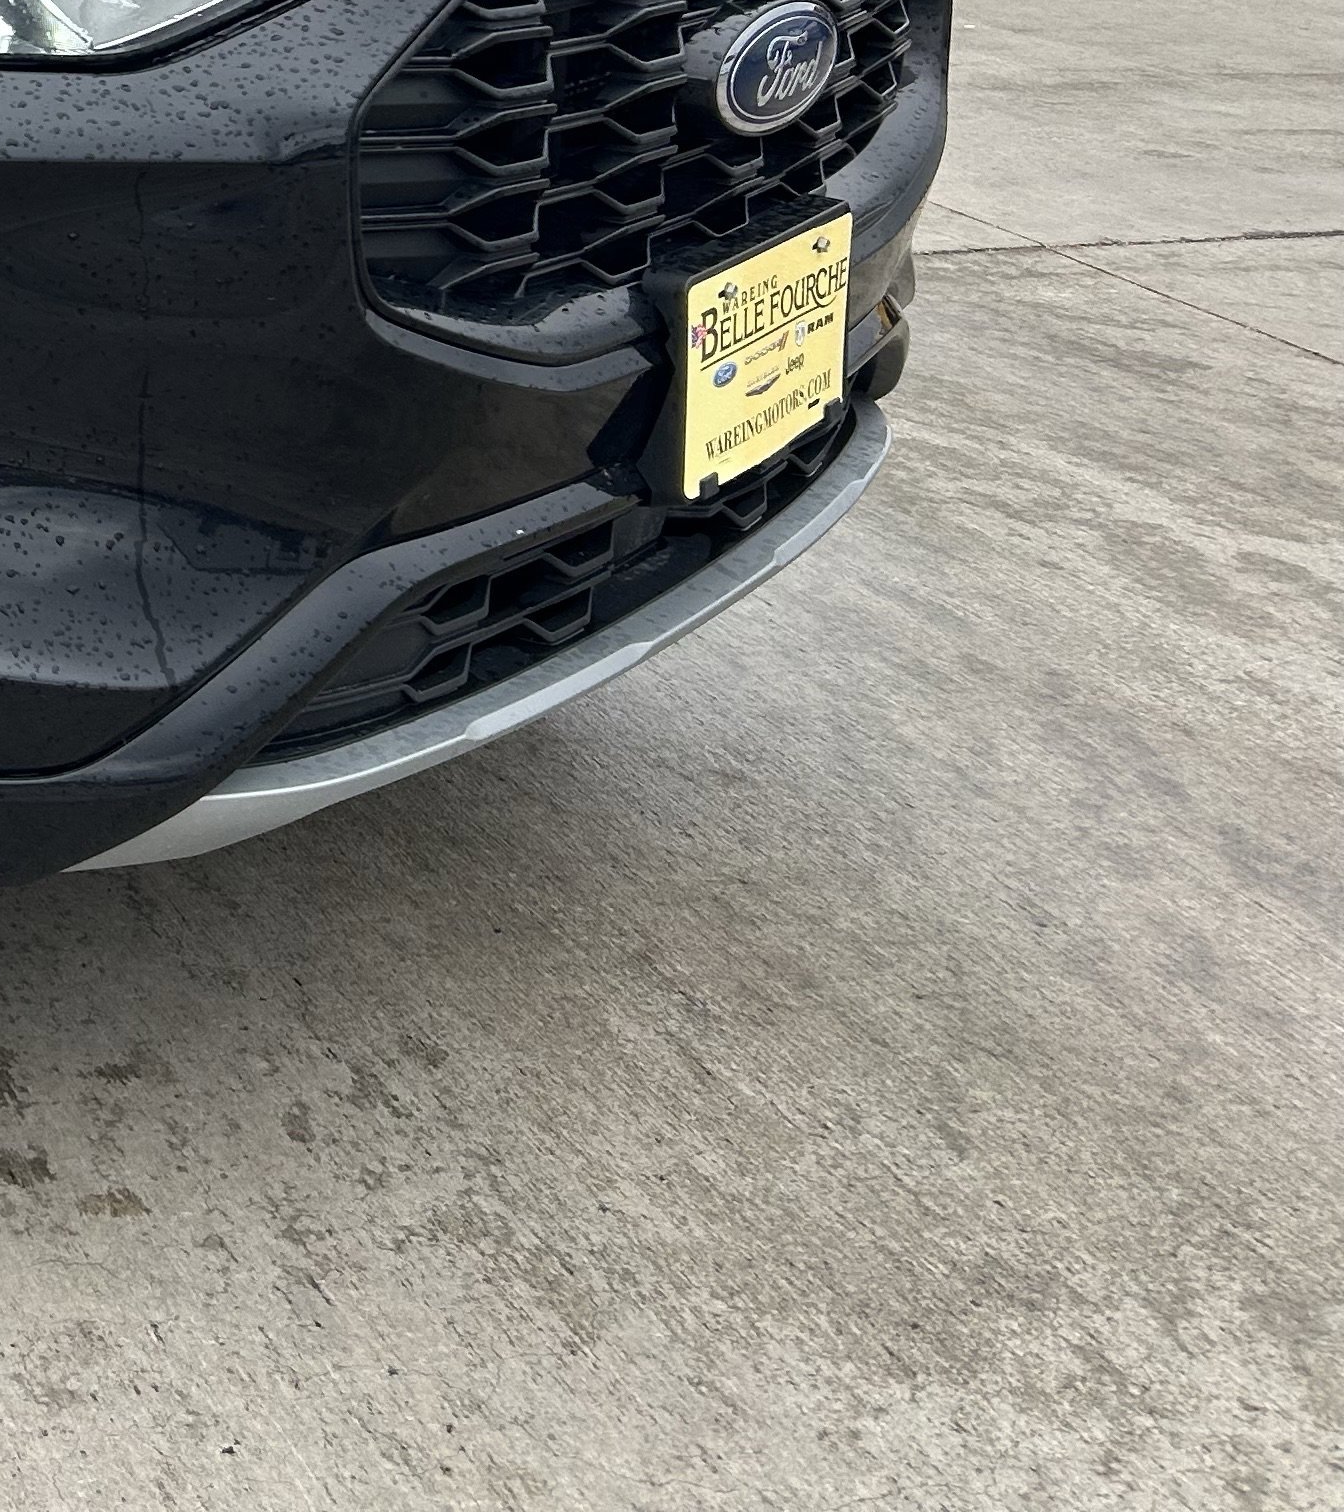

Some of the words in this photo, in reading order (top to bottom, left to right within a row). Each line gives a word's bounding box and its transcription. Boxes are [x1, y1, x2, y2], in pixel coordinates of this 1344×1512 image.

[757, 30, 823, 108] Ford
[701, 306, 765, 363] BELLE
[769, 256, 848, 327] FOURCHE
[722, 274, 778, 315] WAREING
[807, 312, 834, 335] RAM
[785, 352, 805, 376] Jeep
[705, 368, 832, 462] WAREINGMOTORS.COM
